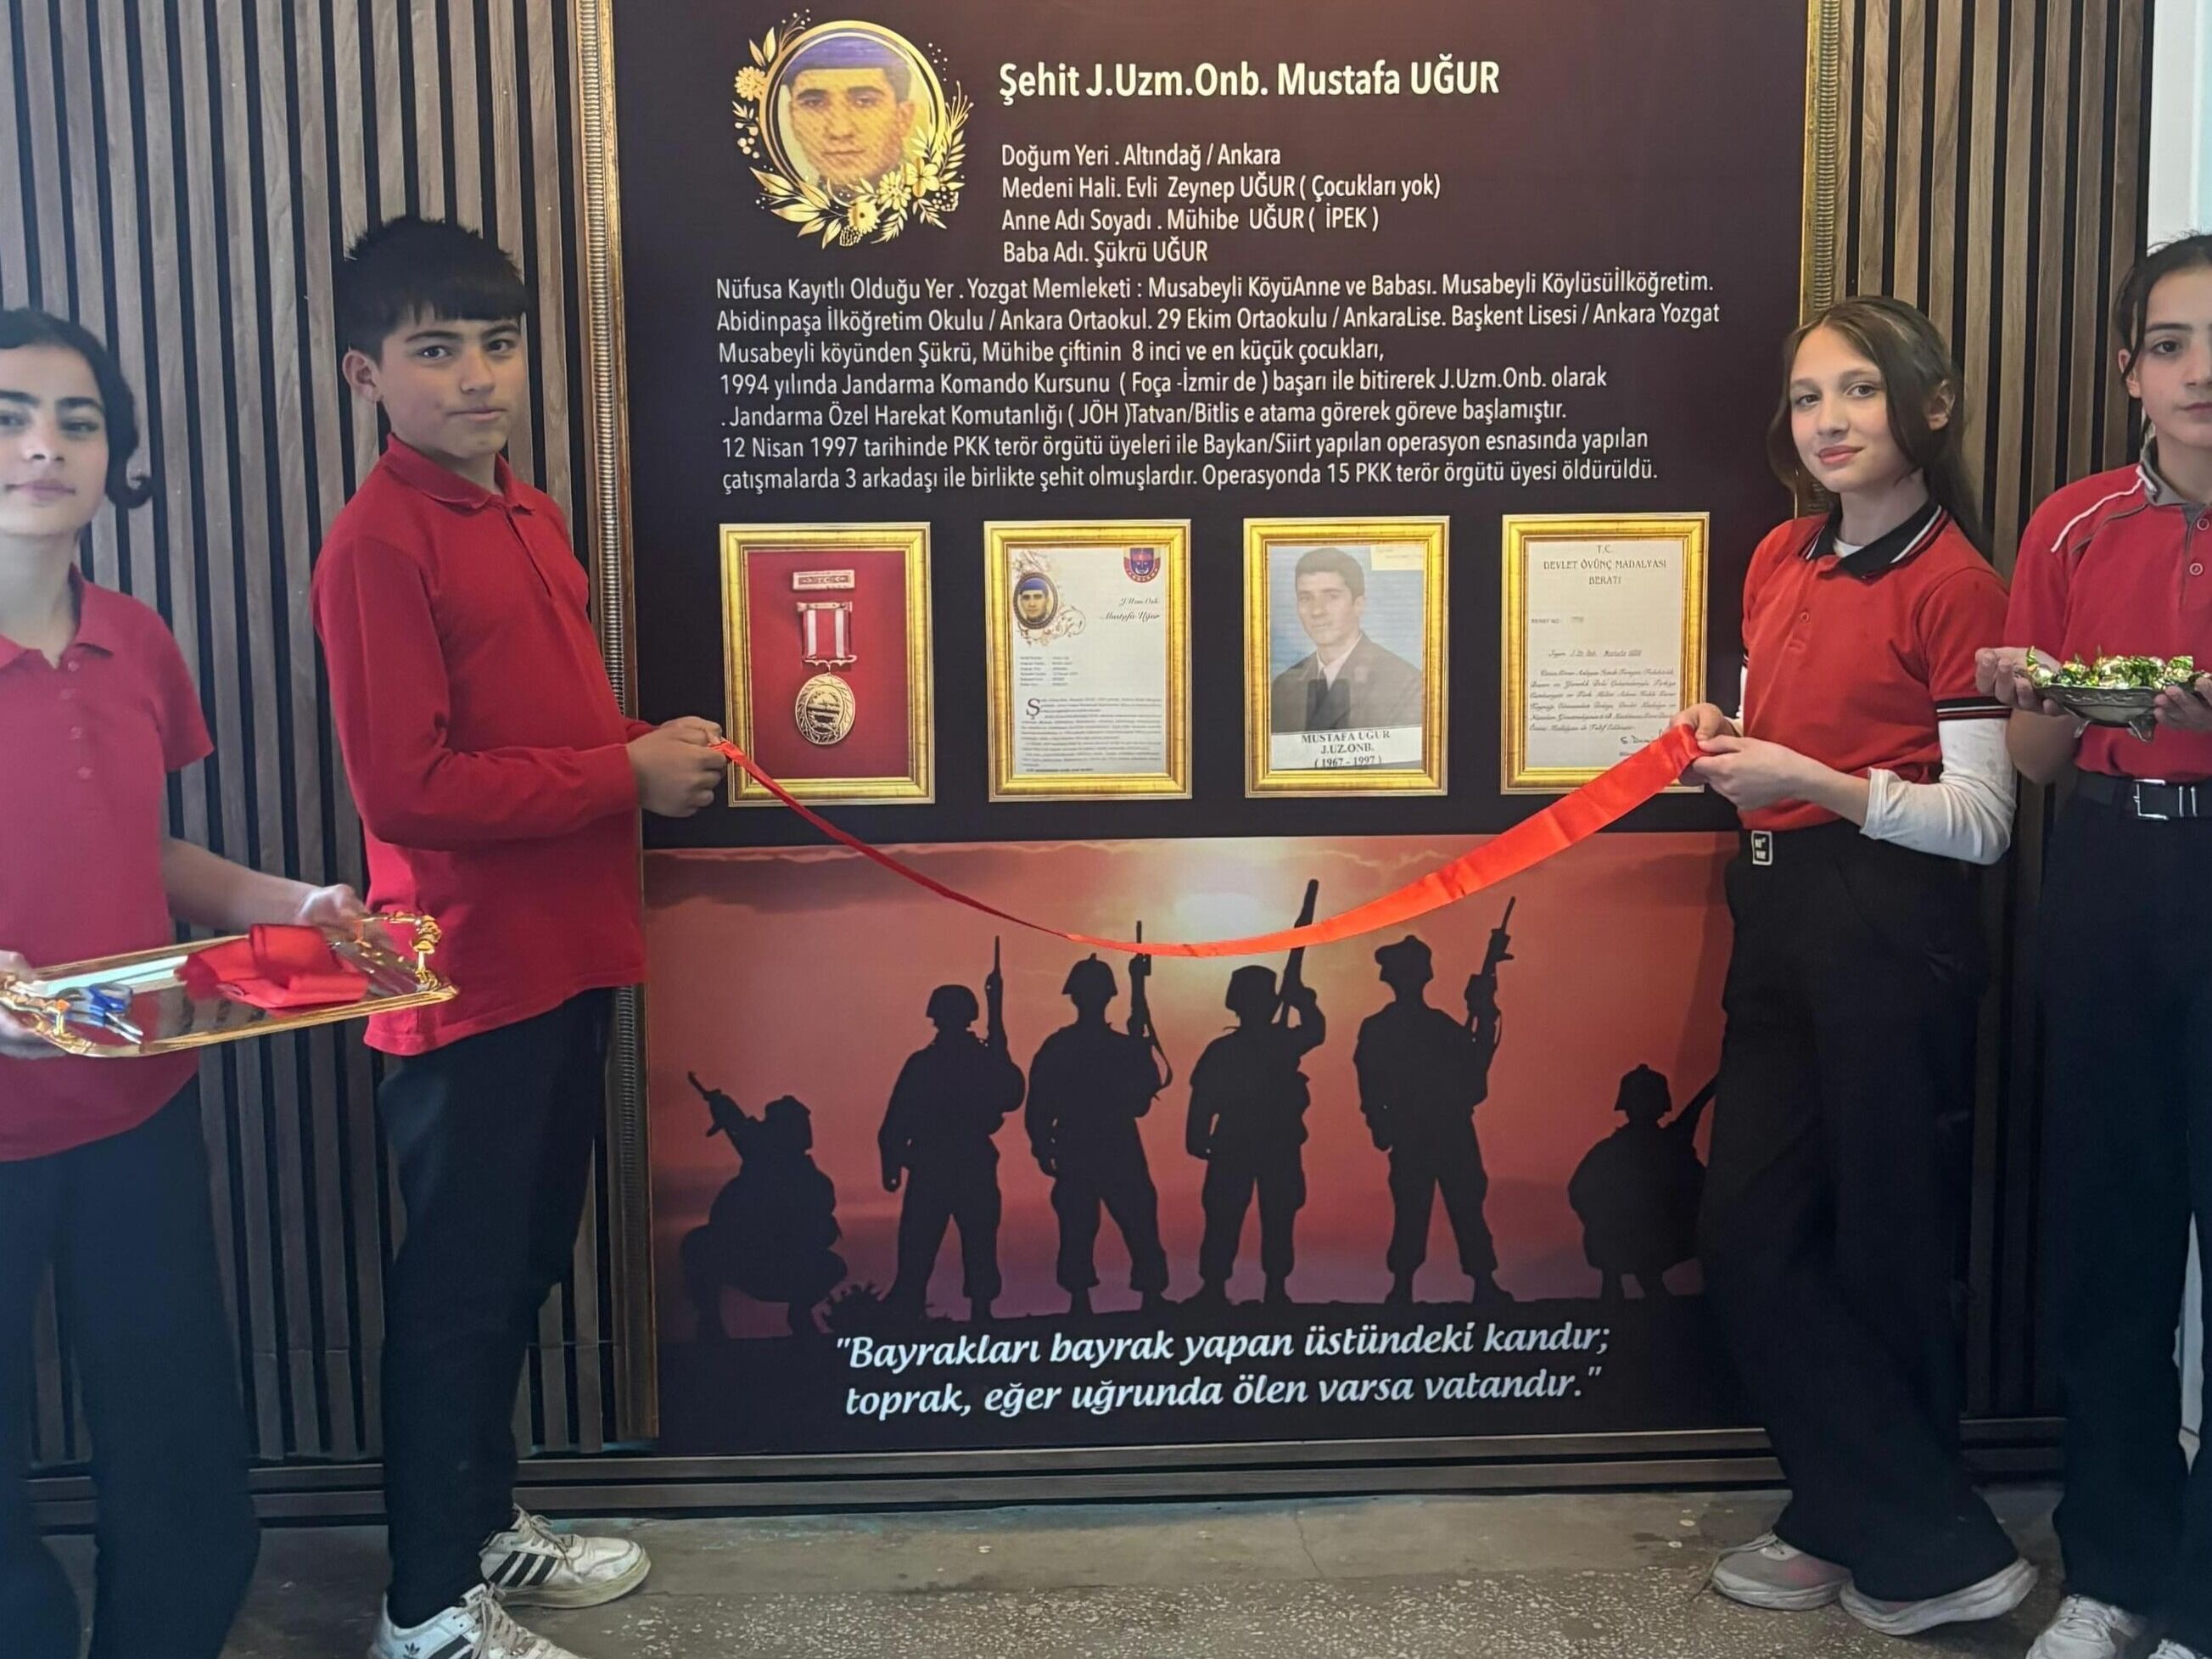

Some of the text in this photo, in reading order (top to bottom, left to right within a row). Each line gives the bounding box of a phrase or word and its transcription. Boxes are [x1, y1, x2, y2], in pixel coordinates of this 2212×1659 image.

[999, 53, 1499, 106] Şehit J.Uzm.Onb. Mustafa UĞUR
[1001, 143, 1071, 172] Doğum
[1074, 143, 1109, 166] Yeri
[1123, 142, 1201, 172] Altındağ
[1217, 142, 1281, 165] Ankara
[1002, 176, 1073, 199] Medeni
[1079, 175, 1122, 199] Hali.
[1127, 175, 1157, 198] Evli
[1168, 176, 1235, 205] Zeynep
[1240, 171, 1296, 198] UĞUR
[1312, 173, 1396, 203] Çocukları
[1001, 209, 1050, 231] Anne
[1054, 207, 1084, 231] Adı
[1090, 207, 1151, 237] Soyadı
[1168, 206, 1240, 231] Mühibe
[1249, 203, 1304, 230] UĞUR
[1326, 202, 1368, 228] İPEK
[1004, 235, 1208, 268] Baba Adı. Şükrü UĞUR
[716, 277, 782, 300] Nüfusa
[788, 277, 844, 305] Kayıtlı
[850, 277, 921, 305] Olduğu
[924, 277, 955, 300] Yer
[966, 277, 1028, 305] Yozgat
[1033, 276, 1131, 299] Memleketi
[1148, 275, 1242, 304] Musabeyli
[1345, 279, 1367, 296] ve
[1372, 273, 1437, 296] Babası.
[1442, 272, 1537, 300] Musabeyli
[716, 309, 821, 338] Abidinpaşa
[827, 305, 922, 338] İlköğretim
[928, 308, 983, 331] Okulu
[1000, 308, 1063, 331] Ankara
[1068, 307, 1152, 331] Ortaokul.
[1157, 308, 1181, 329] 29
[1187, 306, 1231, 329] Ekim
[1236, 305, 1327, 329] Ortaokulu
[1452, 303, 1524, 332] Başkent
[1528, 304, 1577, 325] Lisesi
[1593, 301, 1655, 324] Ankara
[1660, 302, 1720, 328] Yozgat
[719, 337, 1384, 369] Musabeyli köyünden Şükrü, Mühibe çiftinin 8 inci ve en küçük çocukları,
[720, 373, 770, 395] 1994
[774, 373, 837, 401] yılında
[842, 372, 935, 395] Jandarma
[940, 372, 1029, 395] Komando
[1034, 373, 1110, 394] Kursunu
[1132, 371, 1171, 398] Foça
[1233, 369, 1257, 392] de
[1273, 369, 1326, 397] başarı
[1332, 368, 1355, 390] ile
[1359, 367, 1436, 390] bitirerek
[1438, 366, 1547, 390] J.Uzm.Onb.
[1551, 364, 1607, 388] olarak
[729, 404, 823, 427] Jandarma
[828, 401, 868, 426] Özel
[875, 403, 946, 426] Harekat
[951, 402, 1062, 430] Komutanlığı
[1078, 399, 1118, 424] JÖH
[1244, 406, 1255, 423] e
[1259, 404, 1316, 423] atama
[1320, 399, 1391, 428] görerek
[1395, 401, 1458, 427] göreve
[1463, 397, 1566, 425] başlamıştır.
[722, 426, 1648, 462] 12 Nisan 1997 tarihinde PKK terör örgütü üyeleri ile Baykan/Siirt yapılan operasyon esnasında yapılan
[723, 457, 1658, 495] çatışmalarda 3 arkadaşı ile birlikte şehit olmuşlardır. Operasyonda 15 PKK terör örgütü üyesi öldürüldü.
[1543, 560, 1578, 570] DEVLET
[1615, 558, 1666, 569] MADALYASI
[1302, 732, 1356, 744] MUSTAFA
[1322, 757, 1344, 768] 1967
[1353, 755, 1375, 766] 1997
[837, 1321, 1610, 1375] "Bayrakları bayrak yapan üstündeki kandır;
[846, 1382, 972, 1421] toprak,
[984, 1382, 1062, 1418] eğer
[1072, 1376, 1224, 1415] uğrunda
[1233, 1374, 1308, 1404] ölen
[1319, 1378, 1414, 1403] varsa
